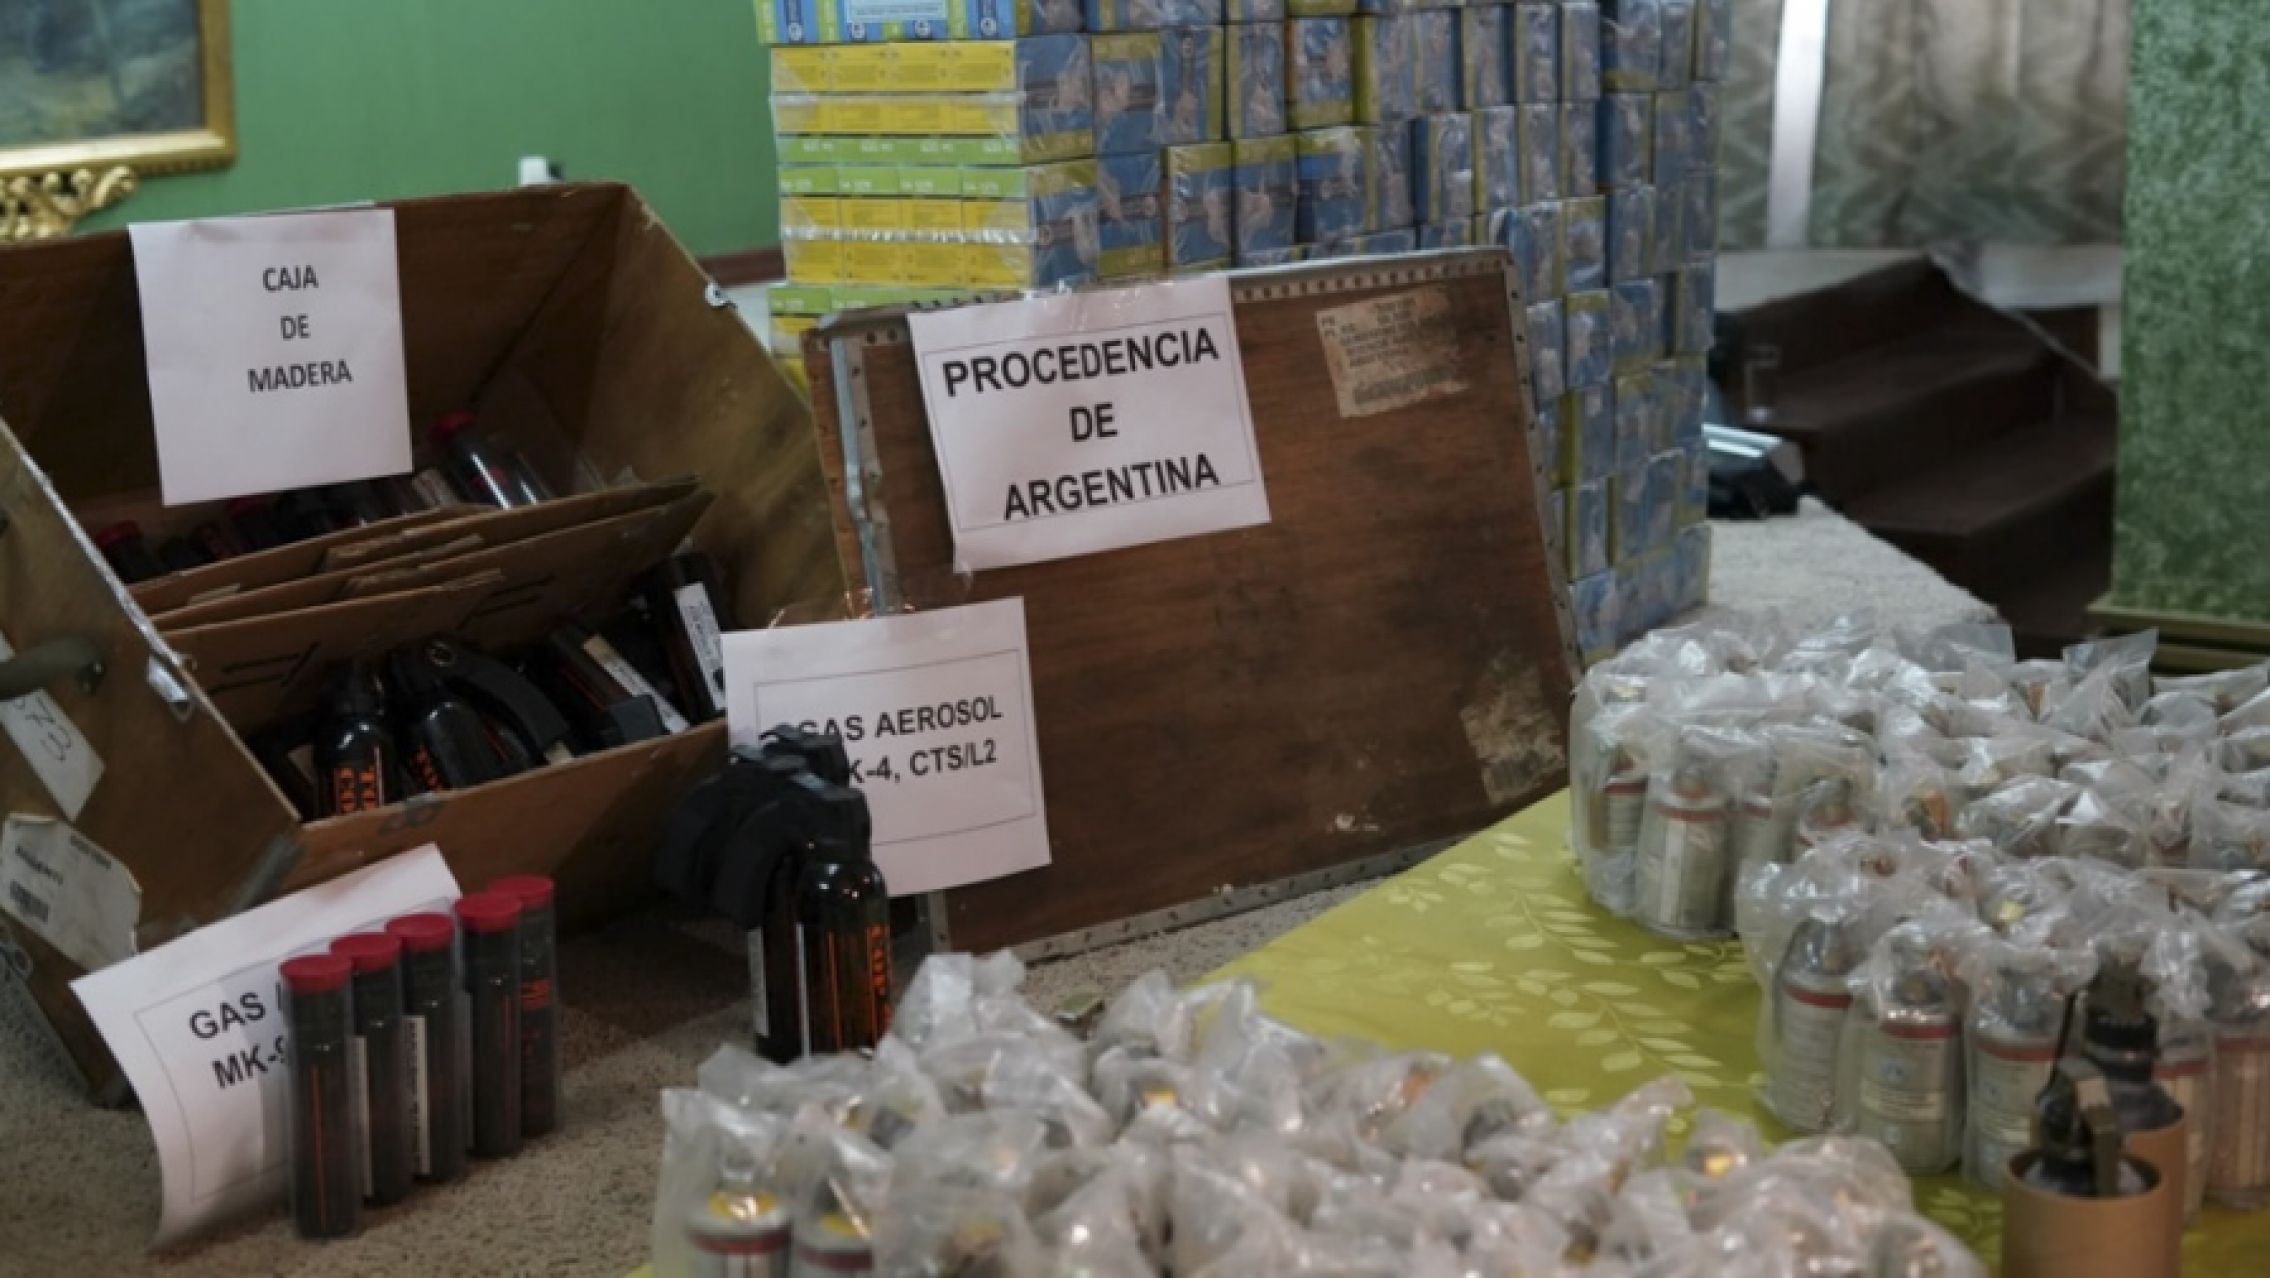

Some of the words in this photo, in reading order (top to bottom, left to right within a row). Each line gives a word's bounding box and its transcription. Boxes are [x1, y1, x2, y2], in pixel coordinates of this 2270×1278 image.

[263, 265, 319, 292] CAJA
[280, 313, 311, 341] DE
[248, 359, 352, 392] MADERA
[942, 328, 1220, 397] PROCEDENCIA
[1069, 402, 1118, 442] DE
[1004, 453, 1221, 520] ARGENTINA
[874, 694, 1004, 739] AEROSOL
[847, 754, 901, 785] K-4,
[910, 738, 997, 777] CTS/L2
[190, 991, 266, 1040] GAS
